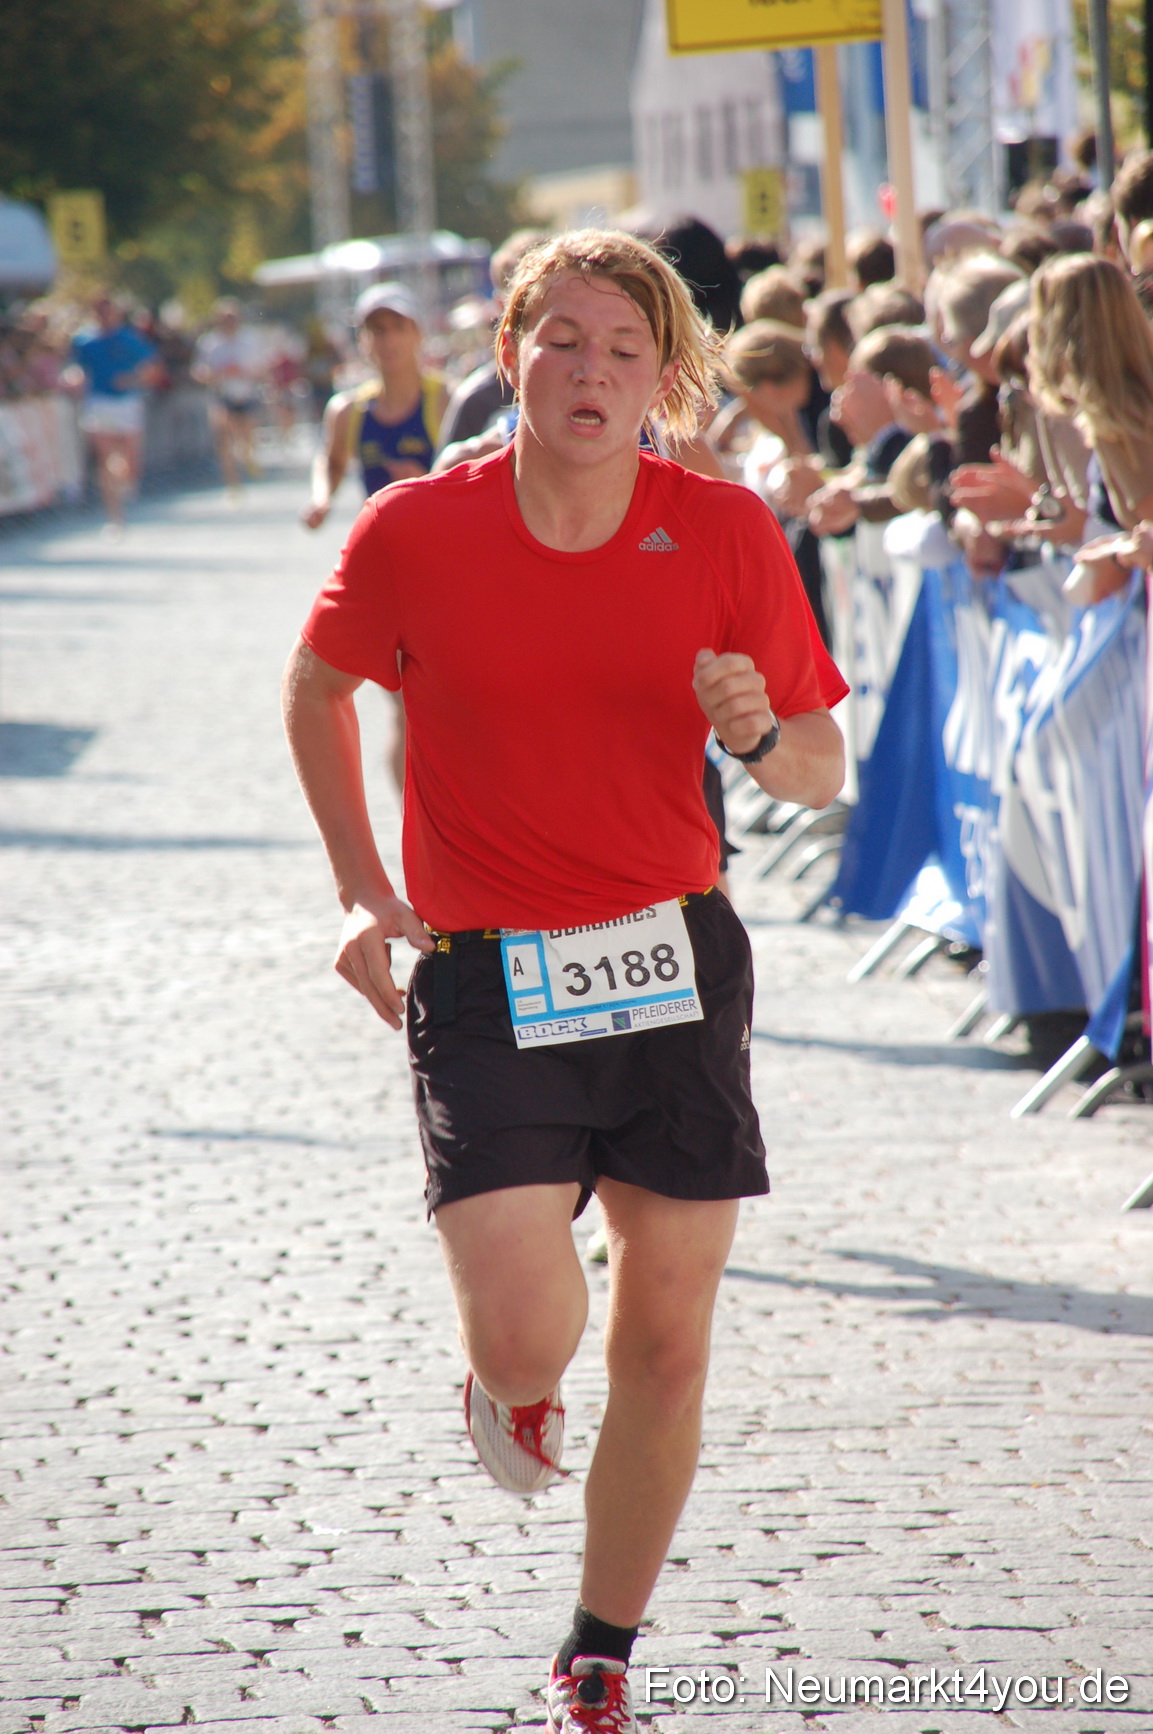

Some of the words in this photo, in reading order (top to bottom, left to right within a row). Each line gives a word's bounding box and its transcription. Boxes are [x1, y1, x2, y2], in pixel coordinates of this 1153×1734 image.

[638, 542, 680, 552] adidas
[513, 956, 524, 977] A
[562, 943, 680, 996] 3188
[632, 998, 698, 1020] PFLEIDERER
[517, 1017, 588, 1040] BOCK
